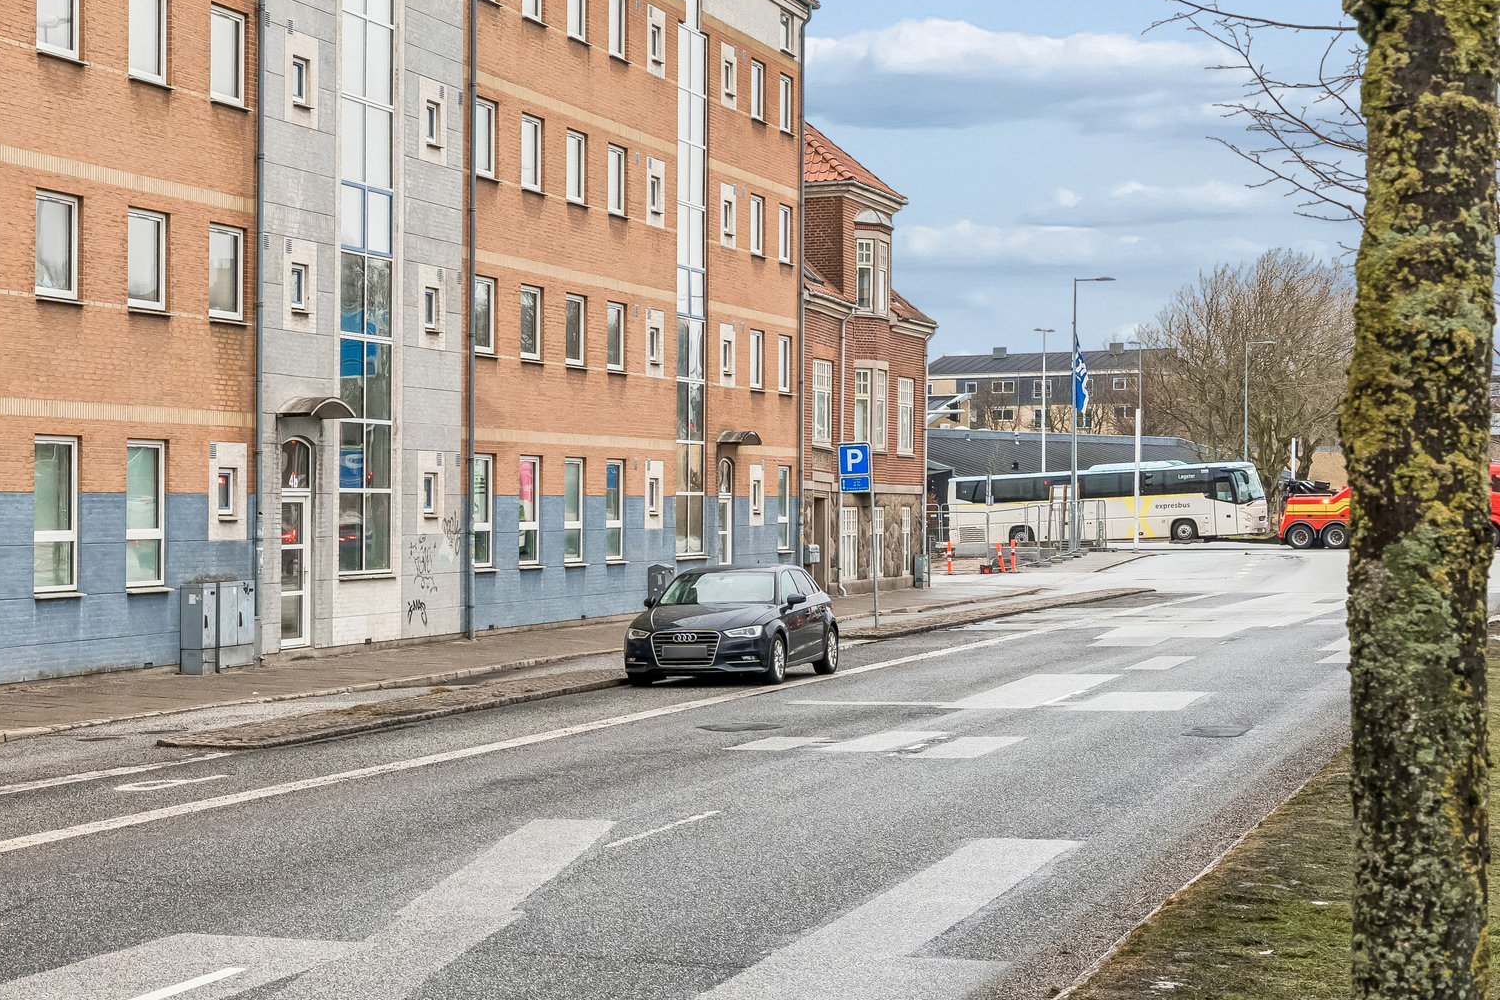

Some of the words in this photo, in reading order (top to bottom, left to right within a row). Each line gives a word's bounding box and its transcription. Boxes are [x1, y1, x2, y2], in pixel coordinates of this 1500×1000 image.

[847, 449, 863, 472] P
[288, 474, 299, 488] 4b
[1155, 502, 1191, 510] expresbus
